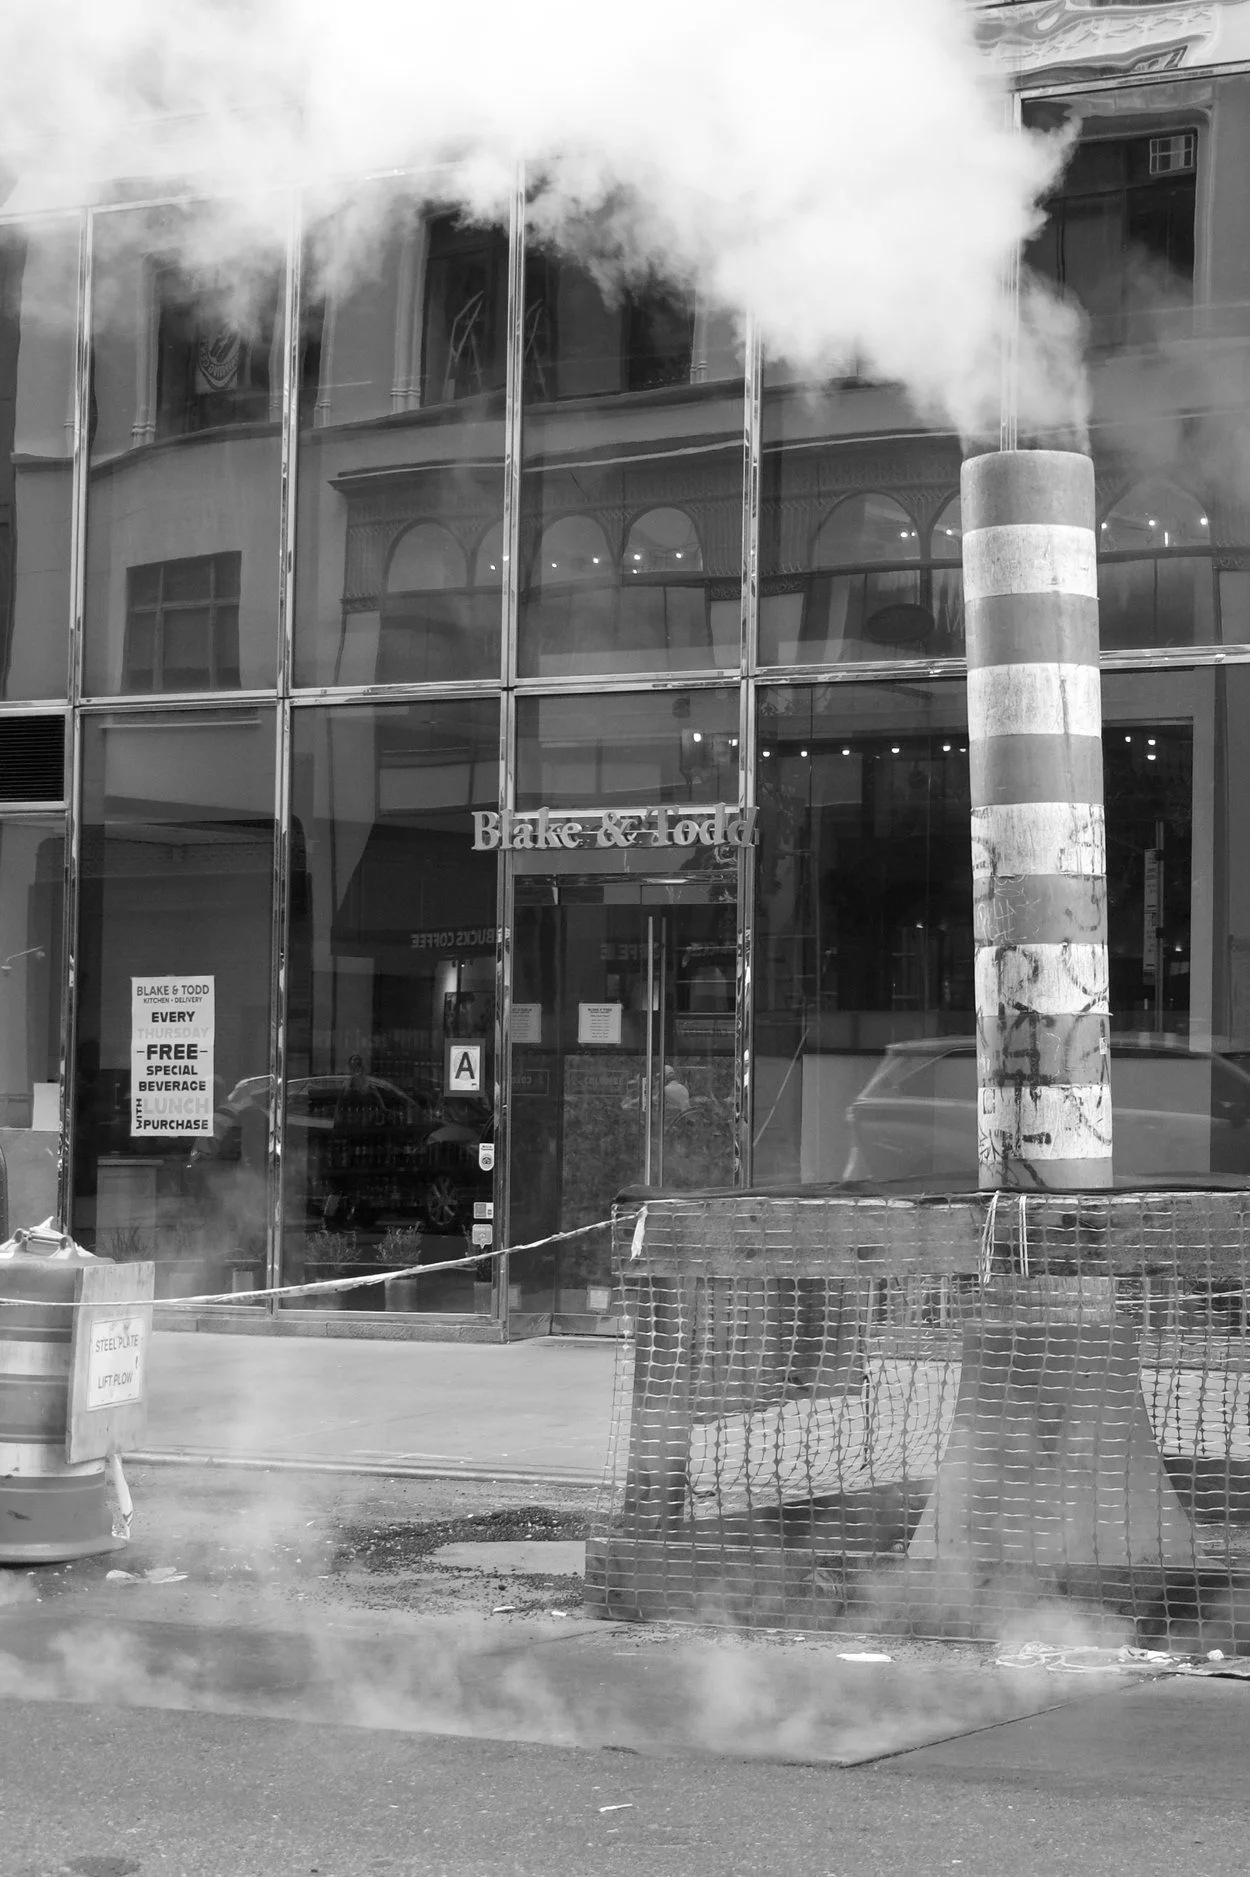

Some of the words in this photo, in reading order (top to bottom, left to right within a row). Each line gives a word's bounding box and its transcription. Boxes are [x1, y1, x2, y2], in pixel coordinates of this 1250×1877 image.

[471, 805, 583, 850] Blake
[597, 811, 637, 847] &
[643, 802, 759, 848] Todd
[136, 985, 169, 997] BLAKE
[172, 985, 179, 996] &
[181, 984, 210, 995] TODD
[151, 1011, 195, 1023] EVERY
[137, 1026, 209, 1040] THURSDAY
[146, 1043, 198, 1060] FREE
[146, 1065, 198, 1076] SPECIAL
[455, 1051, 475, 1079] A
[138, 1080, 206, 1092] BEVERAGE
[135, 1098, 143, 1130] WITH
[144, 1097, 209, 1115] LUNCH
[143, 1119, 209, 1130] PURCHASE
[95, 1336, 117, 1352] STEEL
[118, 1334, 139, 1349] PLATE
[97, 1375, 112, 1389] LIFT
[113, 1372, 133, 1385] PLOW
